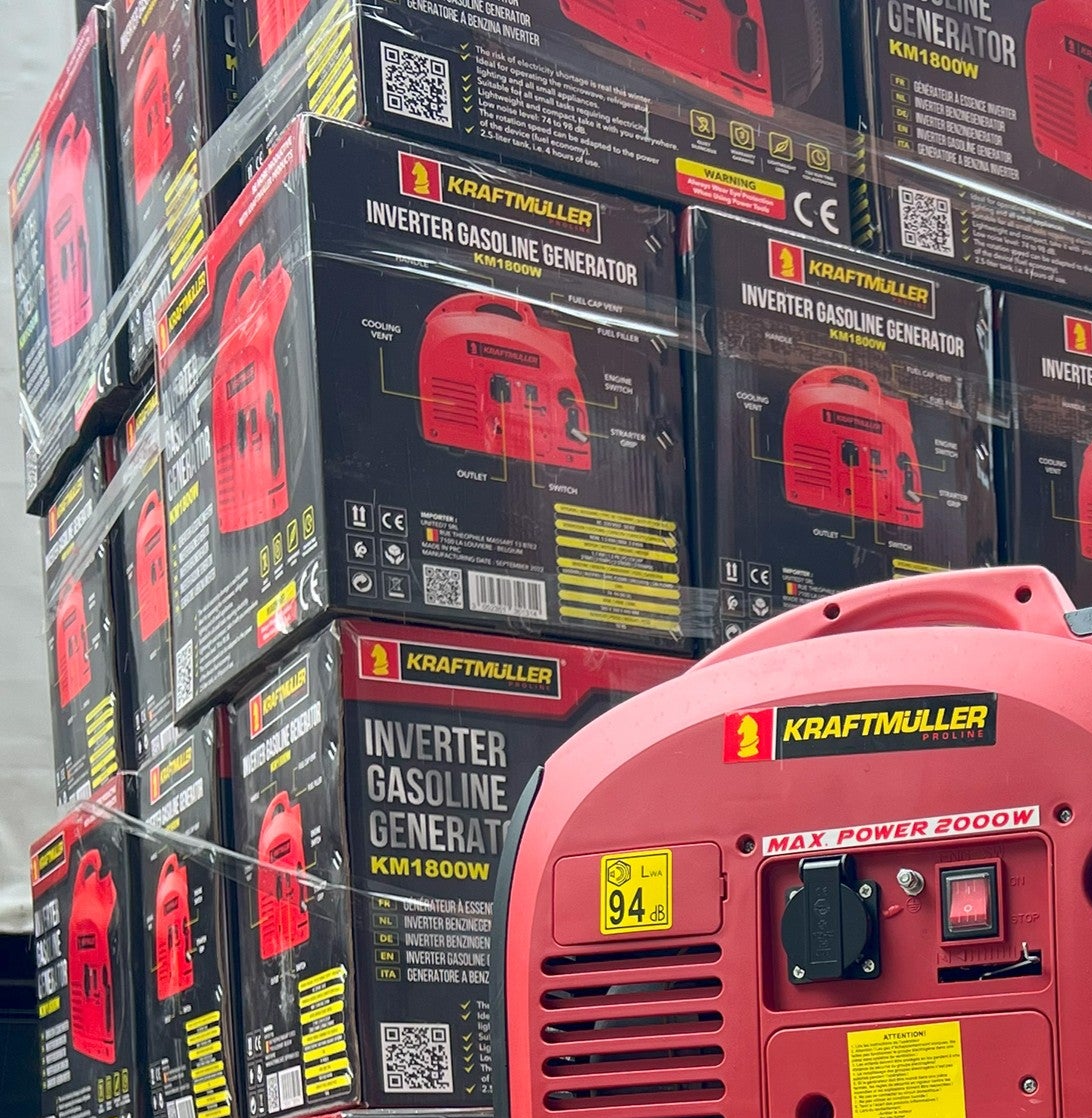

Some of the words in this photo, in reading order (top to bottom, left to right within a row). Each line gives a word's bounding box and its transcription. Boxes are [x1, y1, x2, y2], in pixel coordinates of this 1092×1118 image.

[888, 1, 1017, 68] GENERATOR
[889, 39, 979, 80] KM1800W
[704, 168, 757, 191] WARNING
[447, 176, 592, 228] KRAFTMÜLLER
[366, 199, 454, 242] INVERTER
[457, 222, 539, 263] GASOLINE
[543, 244, 638, 287] GENERATOR
[473, 252, 543, 278] KM1800W
[808, 259, 929, 304] KRAFTMÜLLER
[361, 318, 401, 333] COOLING
[741, 283, 814, 321] INVERTER
[816, 302, 885, 338] GASOLINE
[886, 319, 965, 358] GENERATOR
[406, 652, 553, 685] KRAFTMÜLLER
[365, 718, 508, 768] INVERTER
[782, 705, 989, 742] KRAFTMÜLLER
[922, 730, 984, 742] PROLINE
[367, 764, 509, 812] GASOLINE
[767, 835, 829, 855] MAX.
[836, 820, 929, 846] POWER
[934, 808, 1035, 833] 2000W
[371, 856, 490, 881] KM1800W
[610, 888, 645, 926] 94
[650, 905, 665, 922] dB
